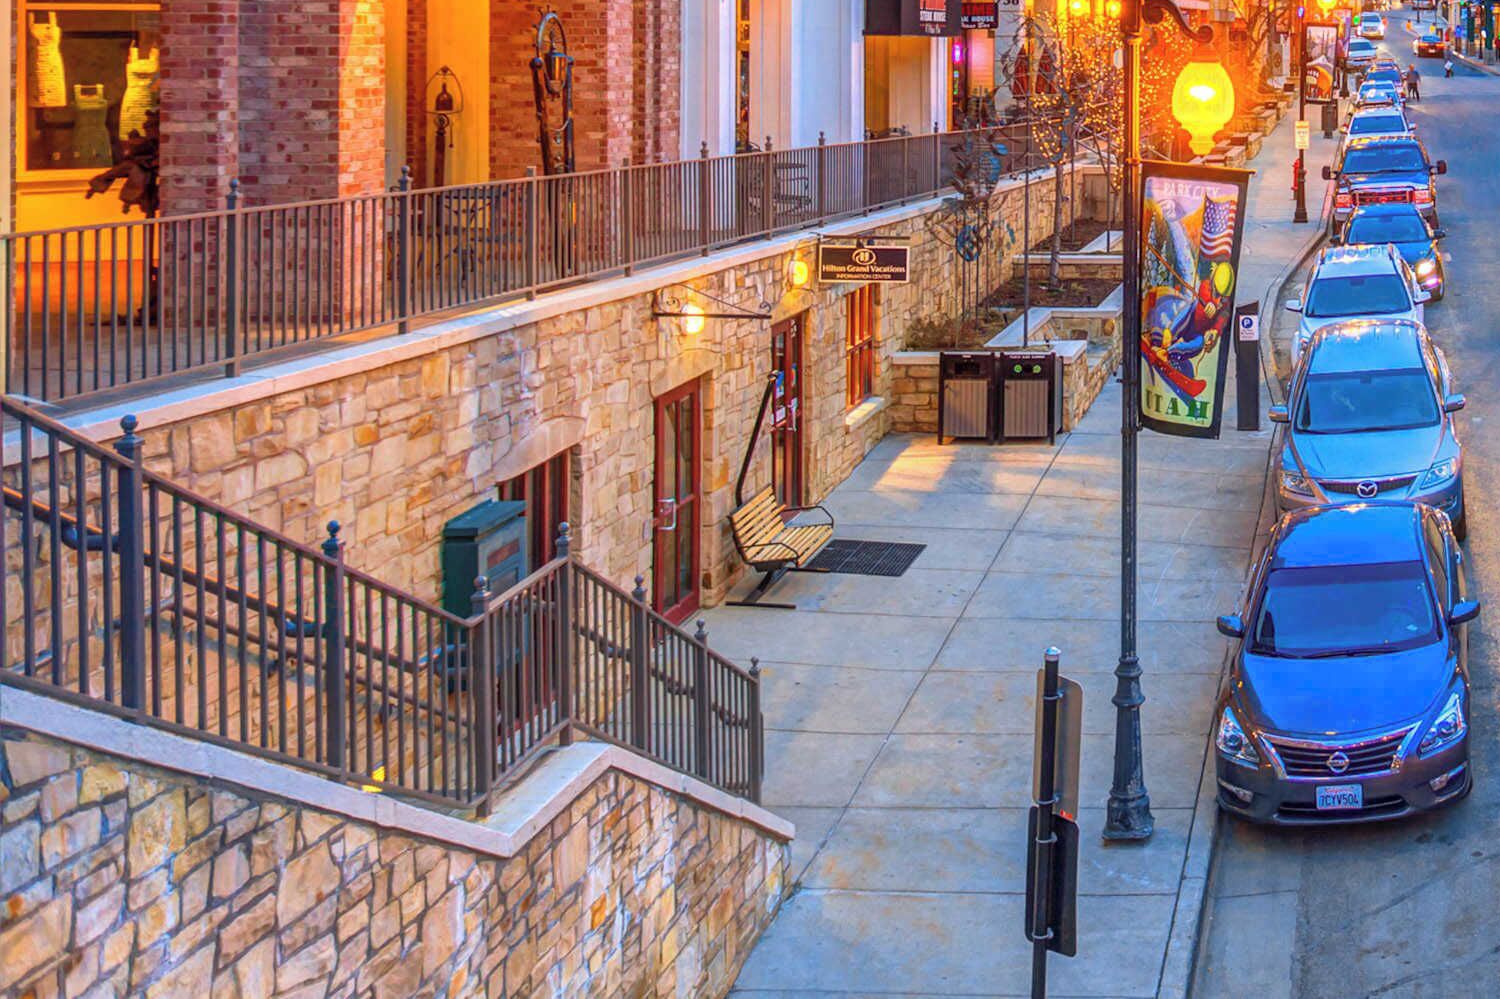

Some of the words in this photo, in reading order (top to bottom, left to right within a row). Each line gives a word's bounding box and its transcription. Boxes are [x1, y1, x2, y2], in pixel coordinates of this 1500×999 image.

[1163, 182, 1191, 196] PARK
[1192, 185, 1220, 200] CITY
[822, 265, 846, 273] Hilton
[847, 265, 870, 273] Grand
[871, 265, 905, 274] Vacations
[1146, 388, 1210, 419] UTAH
